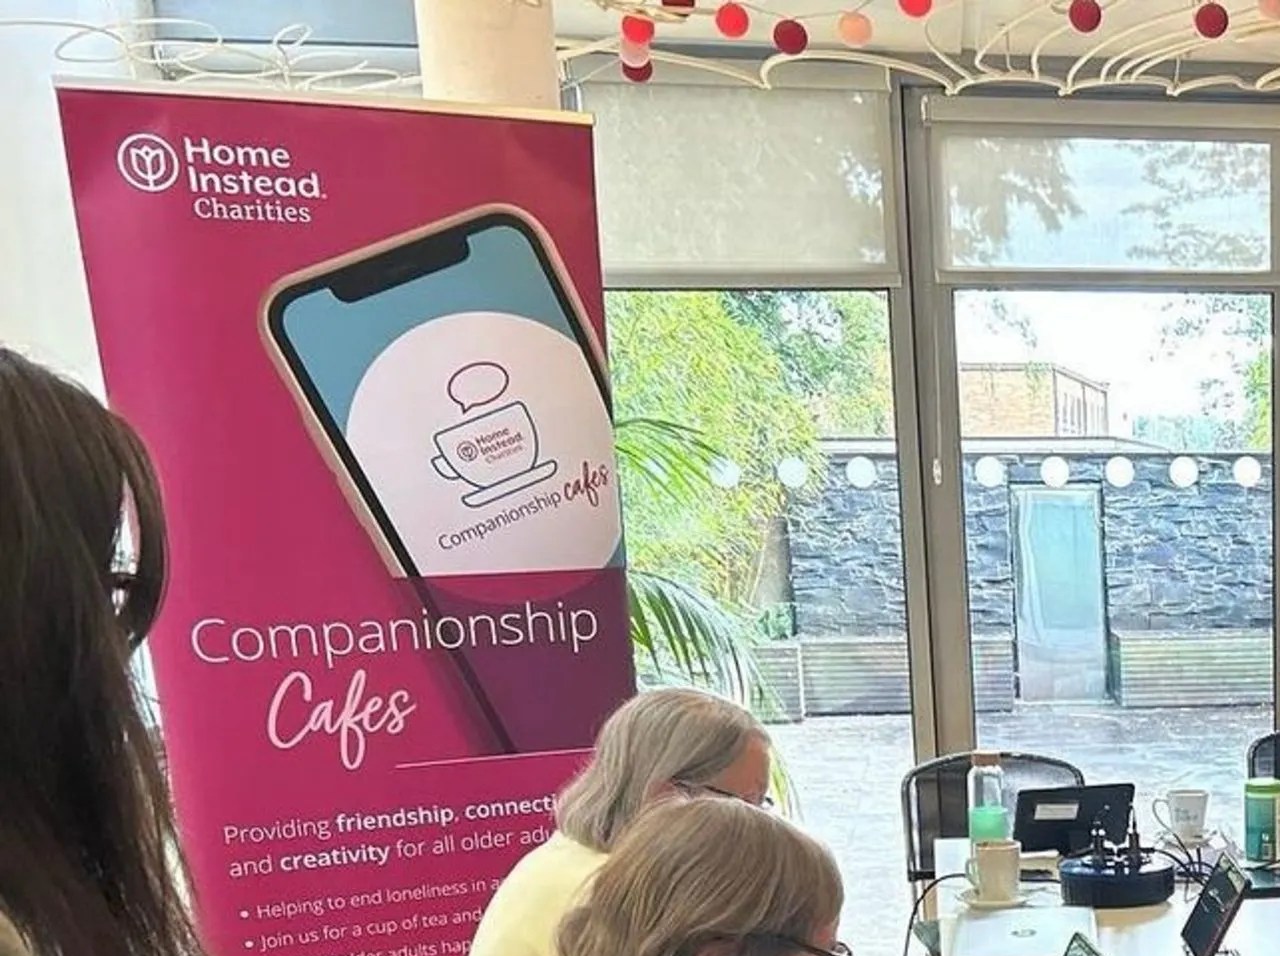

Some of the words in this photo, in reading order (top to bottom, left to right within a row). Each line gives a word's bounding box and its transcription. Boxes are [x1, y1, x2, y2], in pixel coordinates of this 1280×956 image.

[184, 137, 290, 168] Home
[193, 197, 311, 223] Charities
[475, 428, 511, 446] Home
[438, 491, 562, 550] Companionship
[564, 461, 609, 507] cafes
[191, 601, 598, 668] Companionship
[267, 669, 416, 770] Cafes
[223, 818, 332, 845] Providing
[465, 794, 557, 820] connecti
[229, 855, 273, 878] and
[280, 842, 390, 872] creativity
[396, 839, 425, 859] for
[432, 834, 455, 854] all
[461, 831, 513, 852] older
[256, 900, 324, 920] Helping
[327, 896, 346, 910] to
[350, 888, 382, 907] end
[386, 881, 468, 902] loneliness
[472, 879, 487, 893] in
[260, 932, 294, 953] Join
[299, 928, 320, 944] us
[323, 924, 347, 940] for
[352, 925, 362, 937] a
[366, 920, 398, 936] cup
[401, 916, 419, 930] of
[422, 914, 449, 926] tea
[452, 907, 482, 923] and
[441, 939, 471, 955] hap
